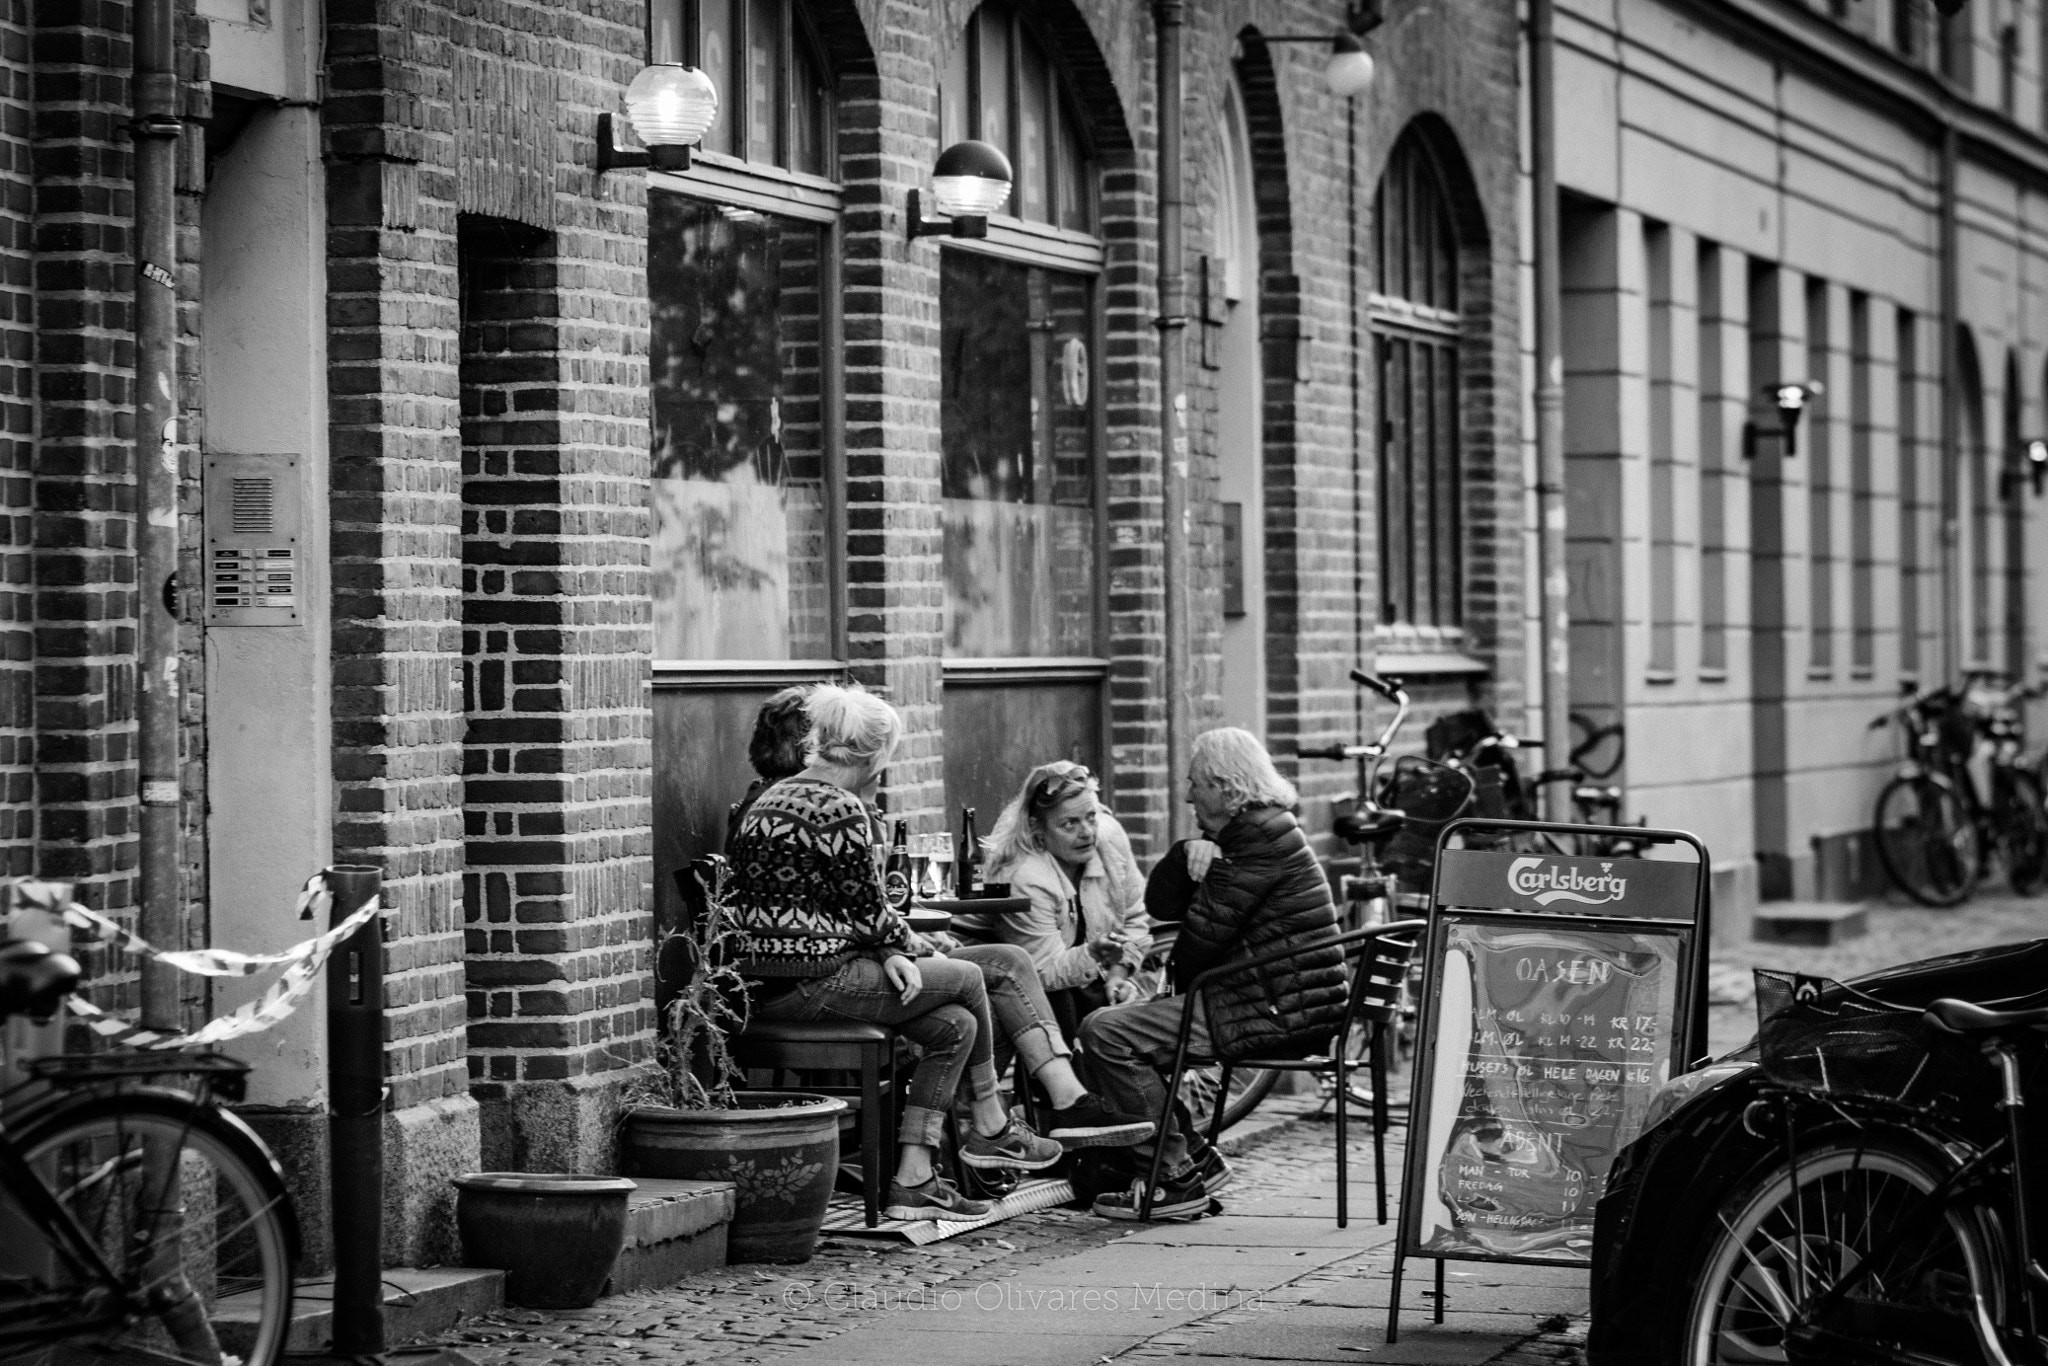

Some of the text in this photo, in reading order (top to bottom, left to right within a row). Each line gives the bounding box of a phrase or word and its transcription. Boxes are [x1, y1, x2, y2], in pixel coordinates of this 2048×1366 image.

[1508, 857, 1627, 903] Carlsberg
[1516, 957, 1610, 985] OASEN
[1609, 1016, 1629, 1031] KR
[1544, 1067, 1577, 1081] HELE
[1585, 1068, 1621, 1083] DAGEN
[1459, 1164, 1485, 1177] MAN
[1508, 1166, 1531, 1179] TOR
[1458, 1179, 1504, 1192] FREDAG
